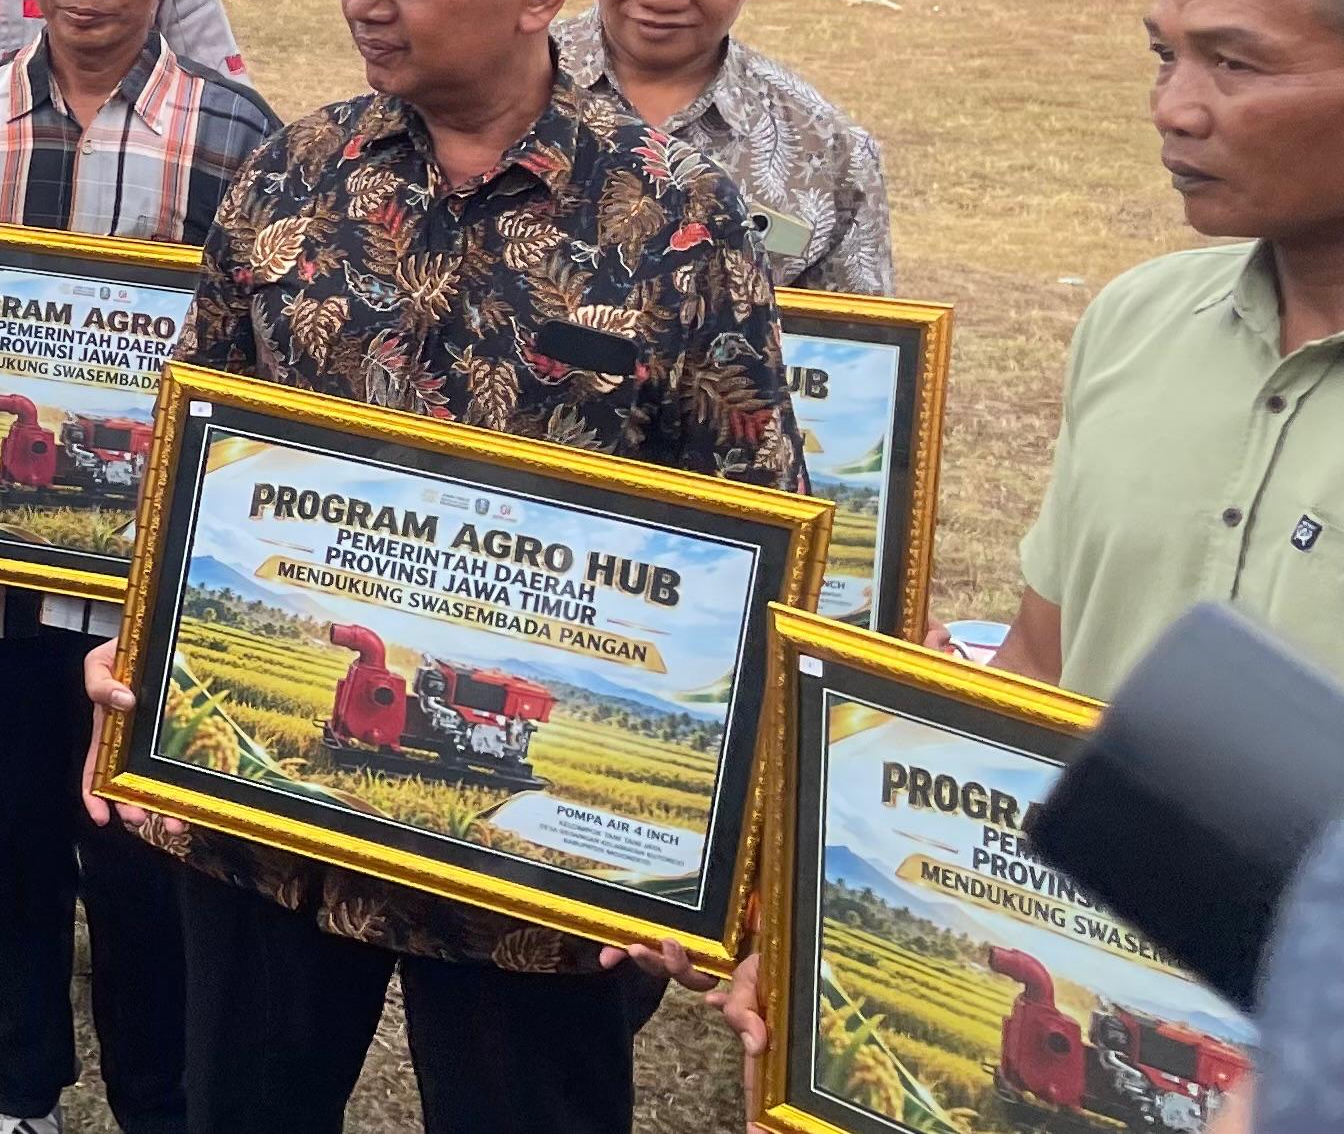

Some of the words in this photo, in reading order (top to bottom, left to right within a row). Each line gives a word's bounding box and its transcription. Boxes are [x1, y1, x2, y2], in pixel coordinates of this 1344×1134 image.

[83, 307, 176, 339] AGRO
[117, 336, 176, 356] DAERA
[53, 364, 160, 389] SWASEMBADA
[78, 347, 130, 368] JAWA
[249, 482, 440, 543] PROGRAM
[450, 523, 574, 573] AGRO
[586, 551, 681, 607] HUB
[336, 528, 487, 579] PEMERINTAH
[494, 565, 596, 603] DAERAH
[277, 561, 402, 605] MENDUKUNG
[408, 591, 552, 641] SWASEMBADA
[559, 627, 647, 663] PANGAN
[325, 546, 436, 589] PROVINSI
[442, 575, 510, 607] JAWA
[519, 590, 597, 626] TIMUR
[557, 805, 603, 826] POMPA
[606, 819, 629, 833] AIR
[634, 826, 642, 837] 4
[646, 828, 679, 846] INCH
[882, 762, 1041, 830] PROGR
[921, 861, 1066, 928] MENDUKUNG
